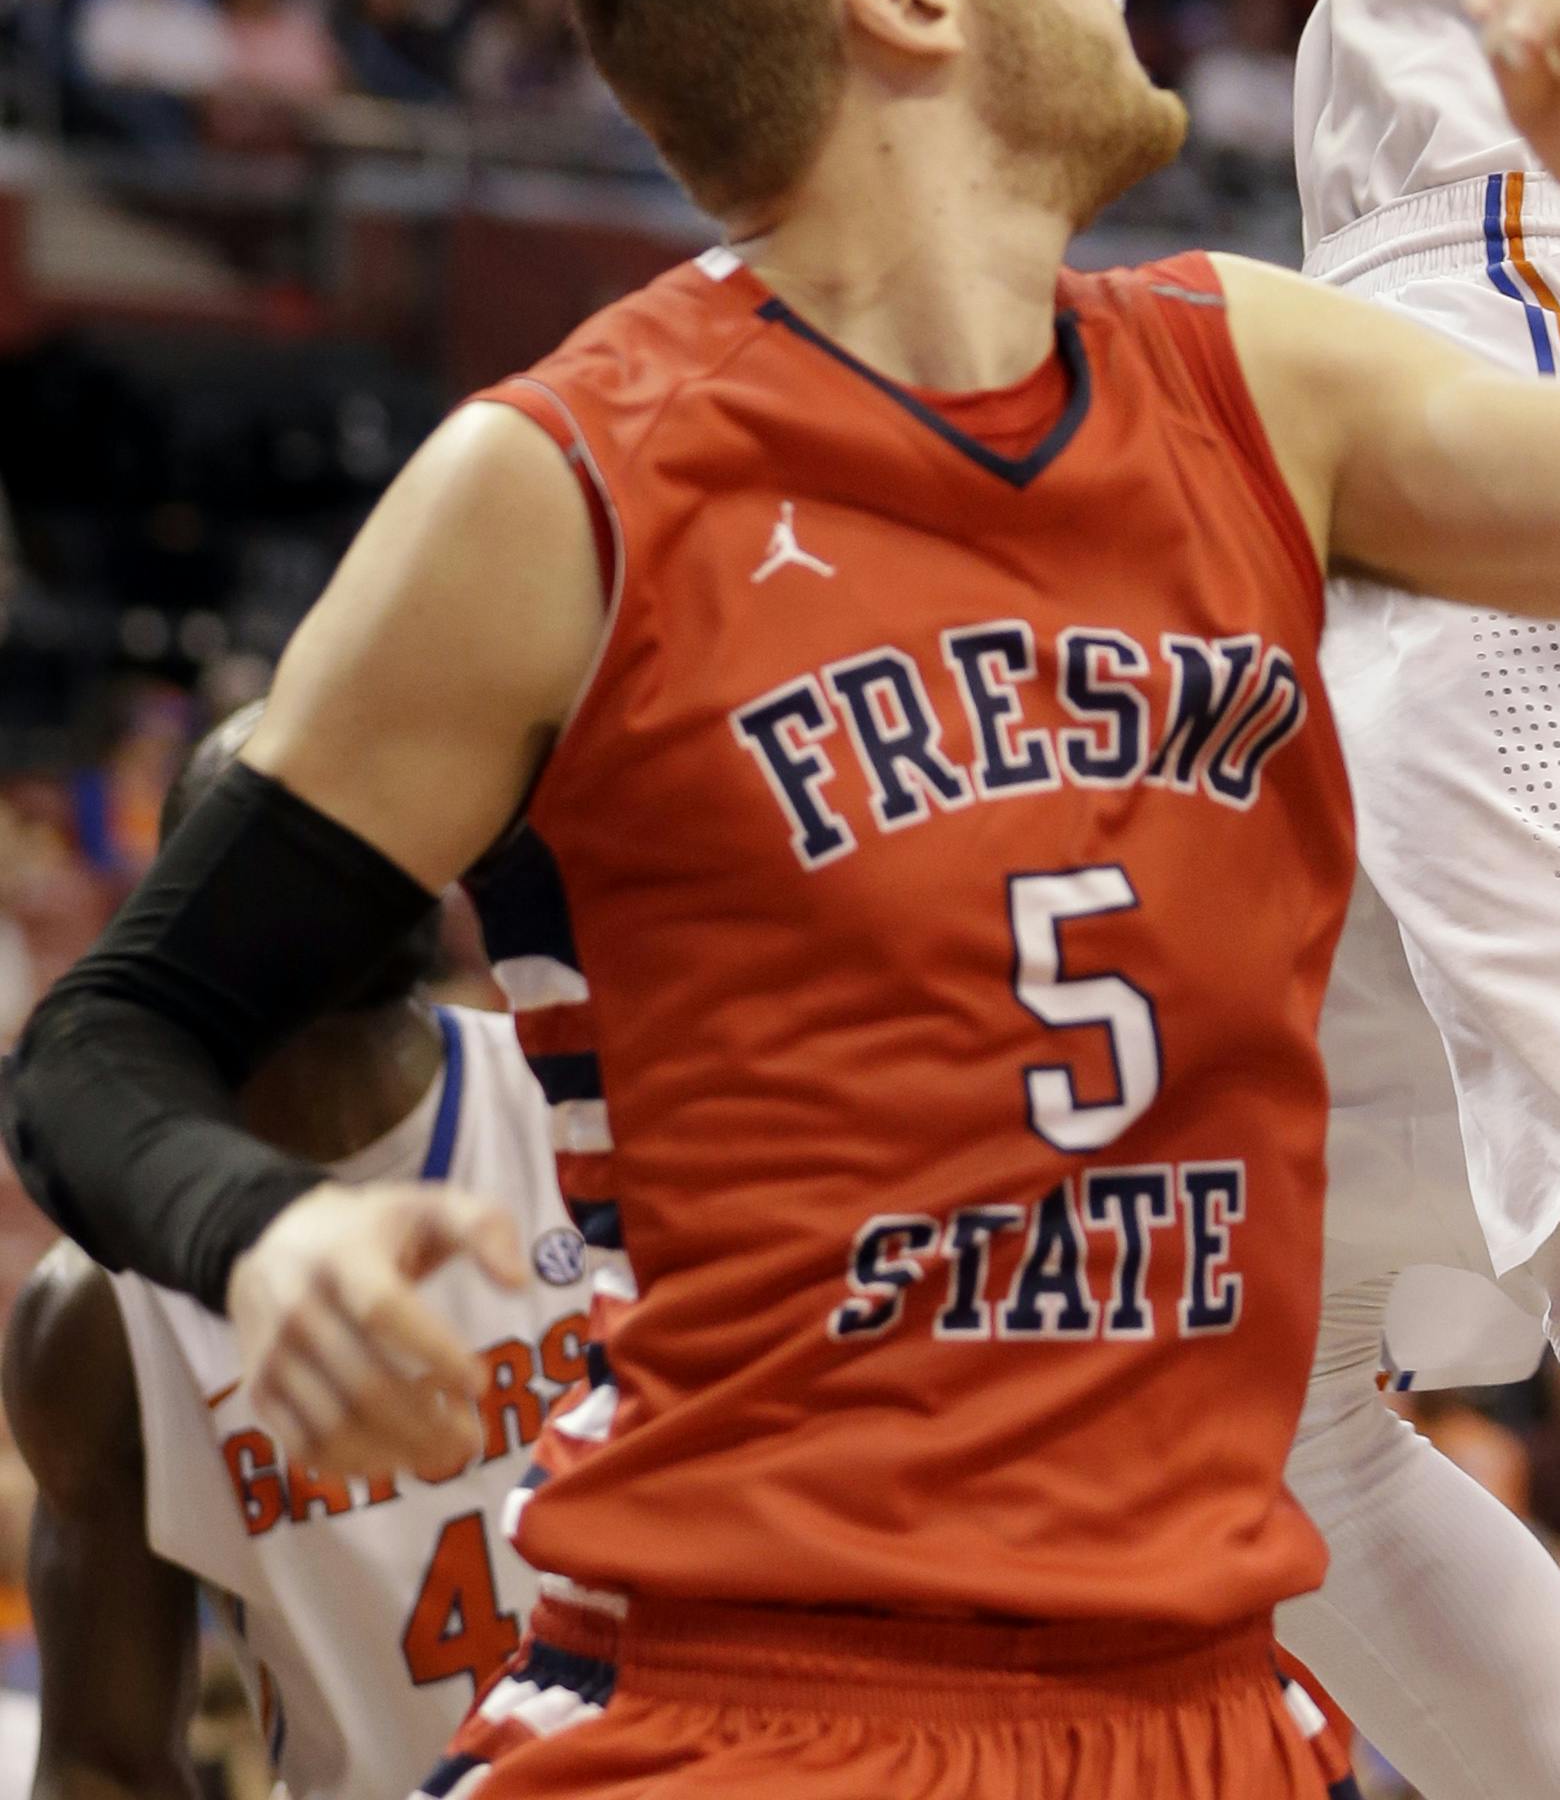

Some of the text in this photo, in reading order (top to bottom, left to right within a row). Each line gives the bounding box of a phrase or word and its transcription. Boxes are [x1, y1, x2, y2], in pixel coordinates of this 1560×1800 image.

[733, 618, 1308, 871] FRESNO
[1006, 863, 1164, 1154] 5
[829, 1159, 1247, 1341] STATE
[221, 1311, 590, 1537] GARS
[403, 1509, 521, 1708] 4
